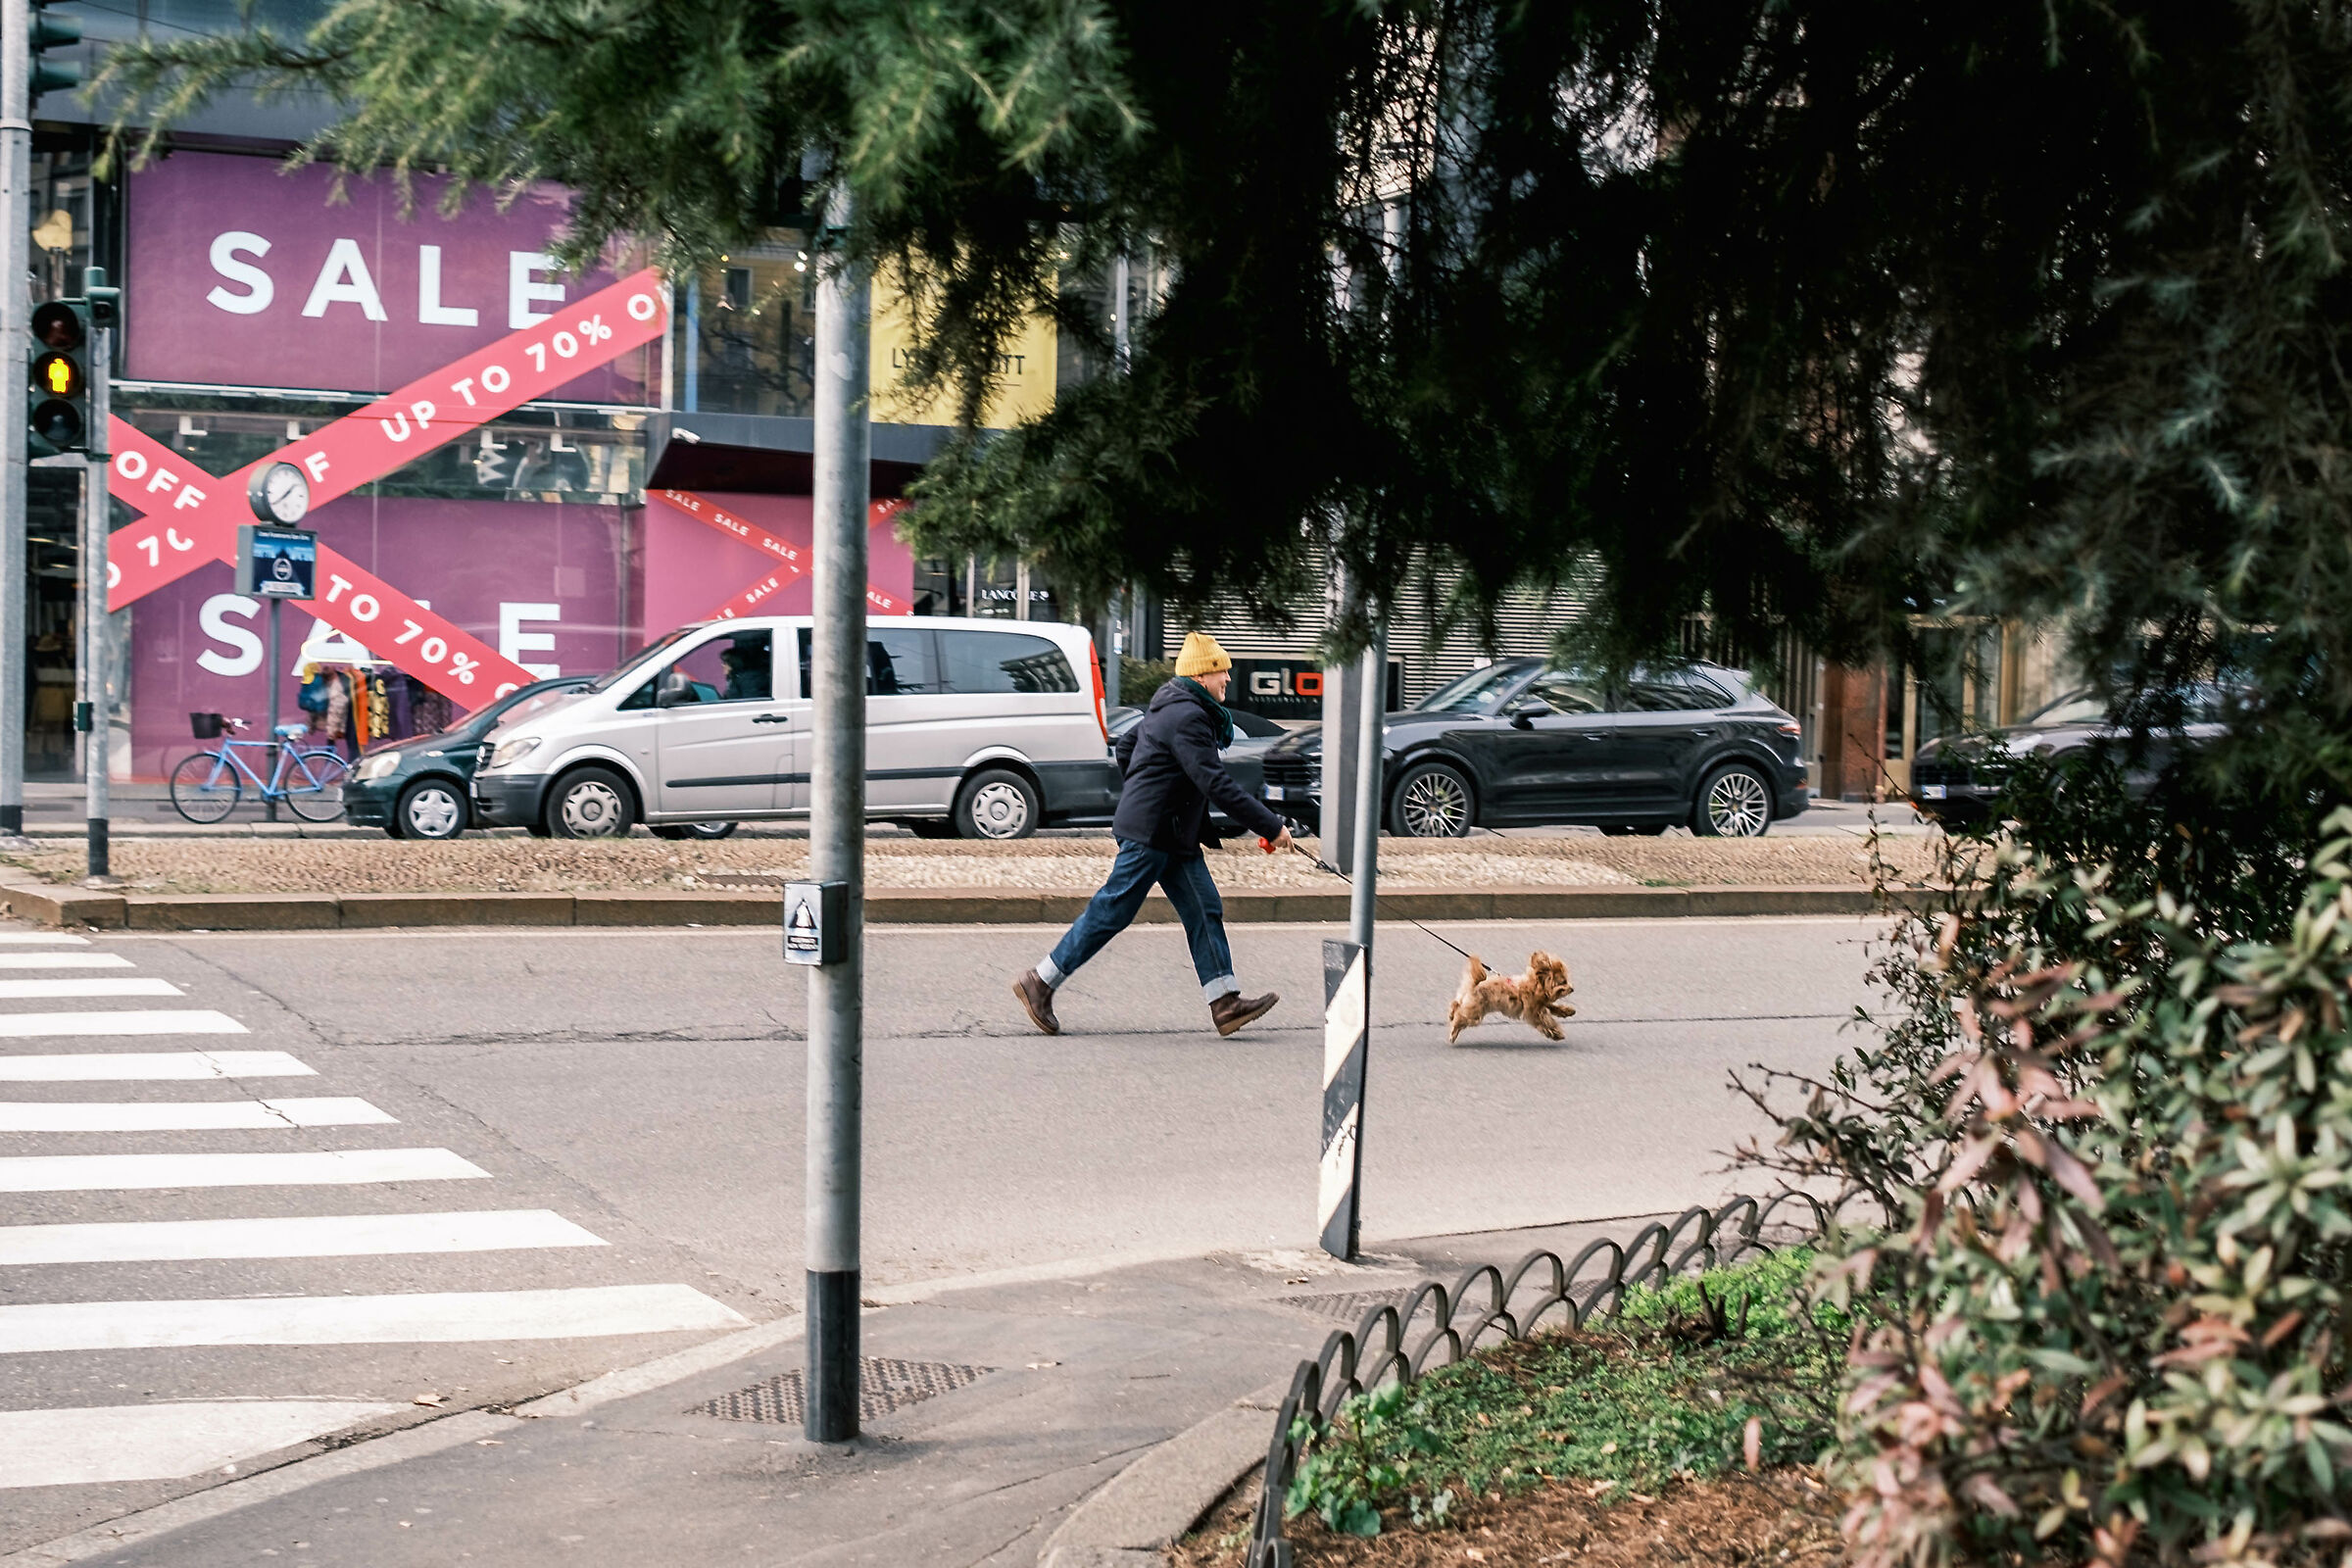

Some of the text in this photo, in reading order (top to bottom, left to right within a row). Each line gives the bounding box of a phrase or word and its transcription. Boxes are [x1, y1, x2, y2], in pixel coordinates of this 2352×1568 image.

[206, 230, 568, 329] SALE
[380, 400, 436, 442] UP
[451, 365, 511, 407] TO
[524, 314, 612, 372] 70%
[116, 450, 207, 511] OFF
[665, 489, 701, 512] SALE
[713, 514, 750, 536] SALE
[762, 538, 798, 561] SALE
[746, 577, 779, 603] SALE
[866, 591, 893, 609] ALE
[196, 593, 561, 680] SAE
[325, 574, 480, 685] TO 70%
